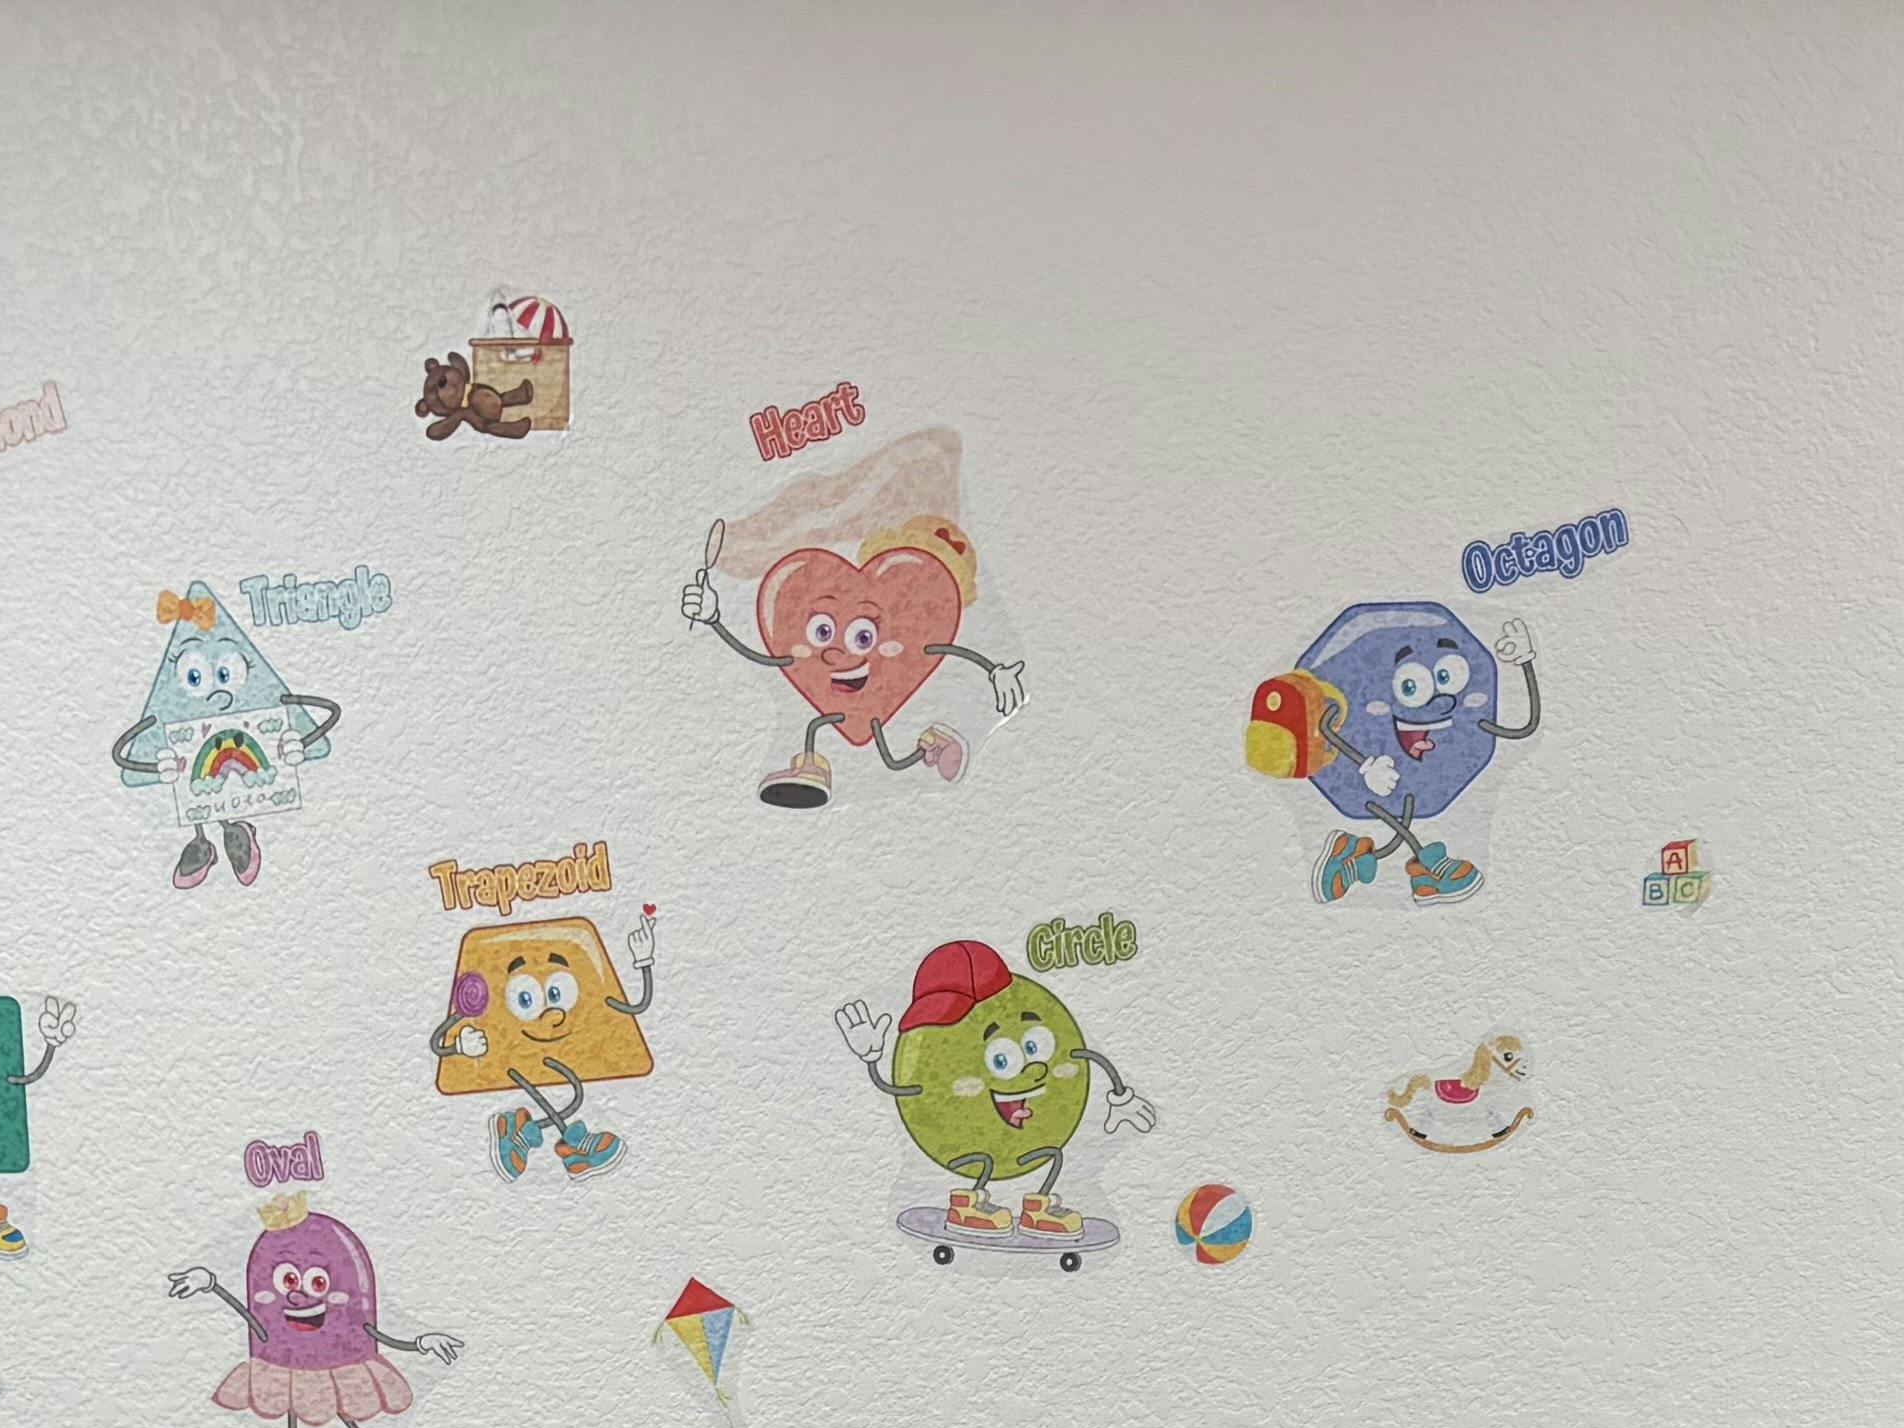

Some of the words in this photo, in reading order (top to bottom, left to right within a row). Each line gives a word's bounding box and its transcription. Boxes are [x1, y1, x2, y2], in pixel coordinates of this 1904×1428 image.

[749, 381, 866, 461] Heart
[1462, 508, 1629, 593] Octagon
[239, 564, 393, 631] Triangle
[429, 840, 612, 917] Trapezoid
[1666, 852, 1683, 870] A
[1026, 912, 1138, 973] Circle
[244, 1131, 324, 1188] Oval
